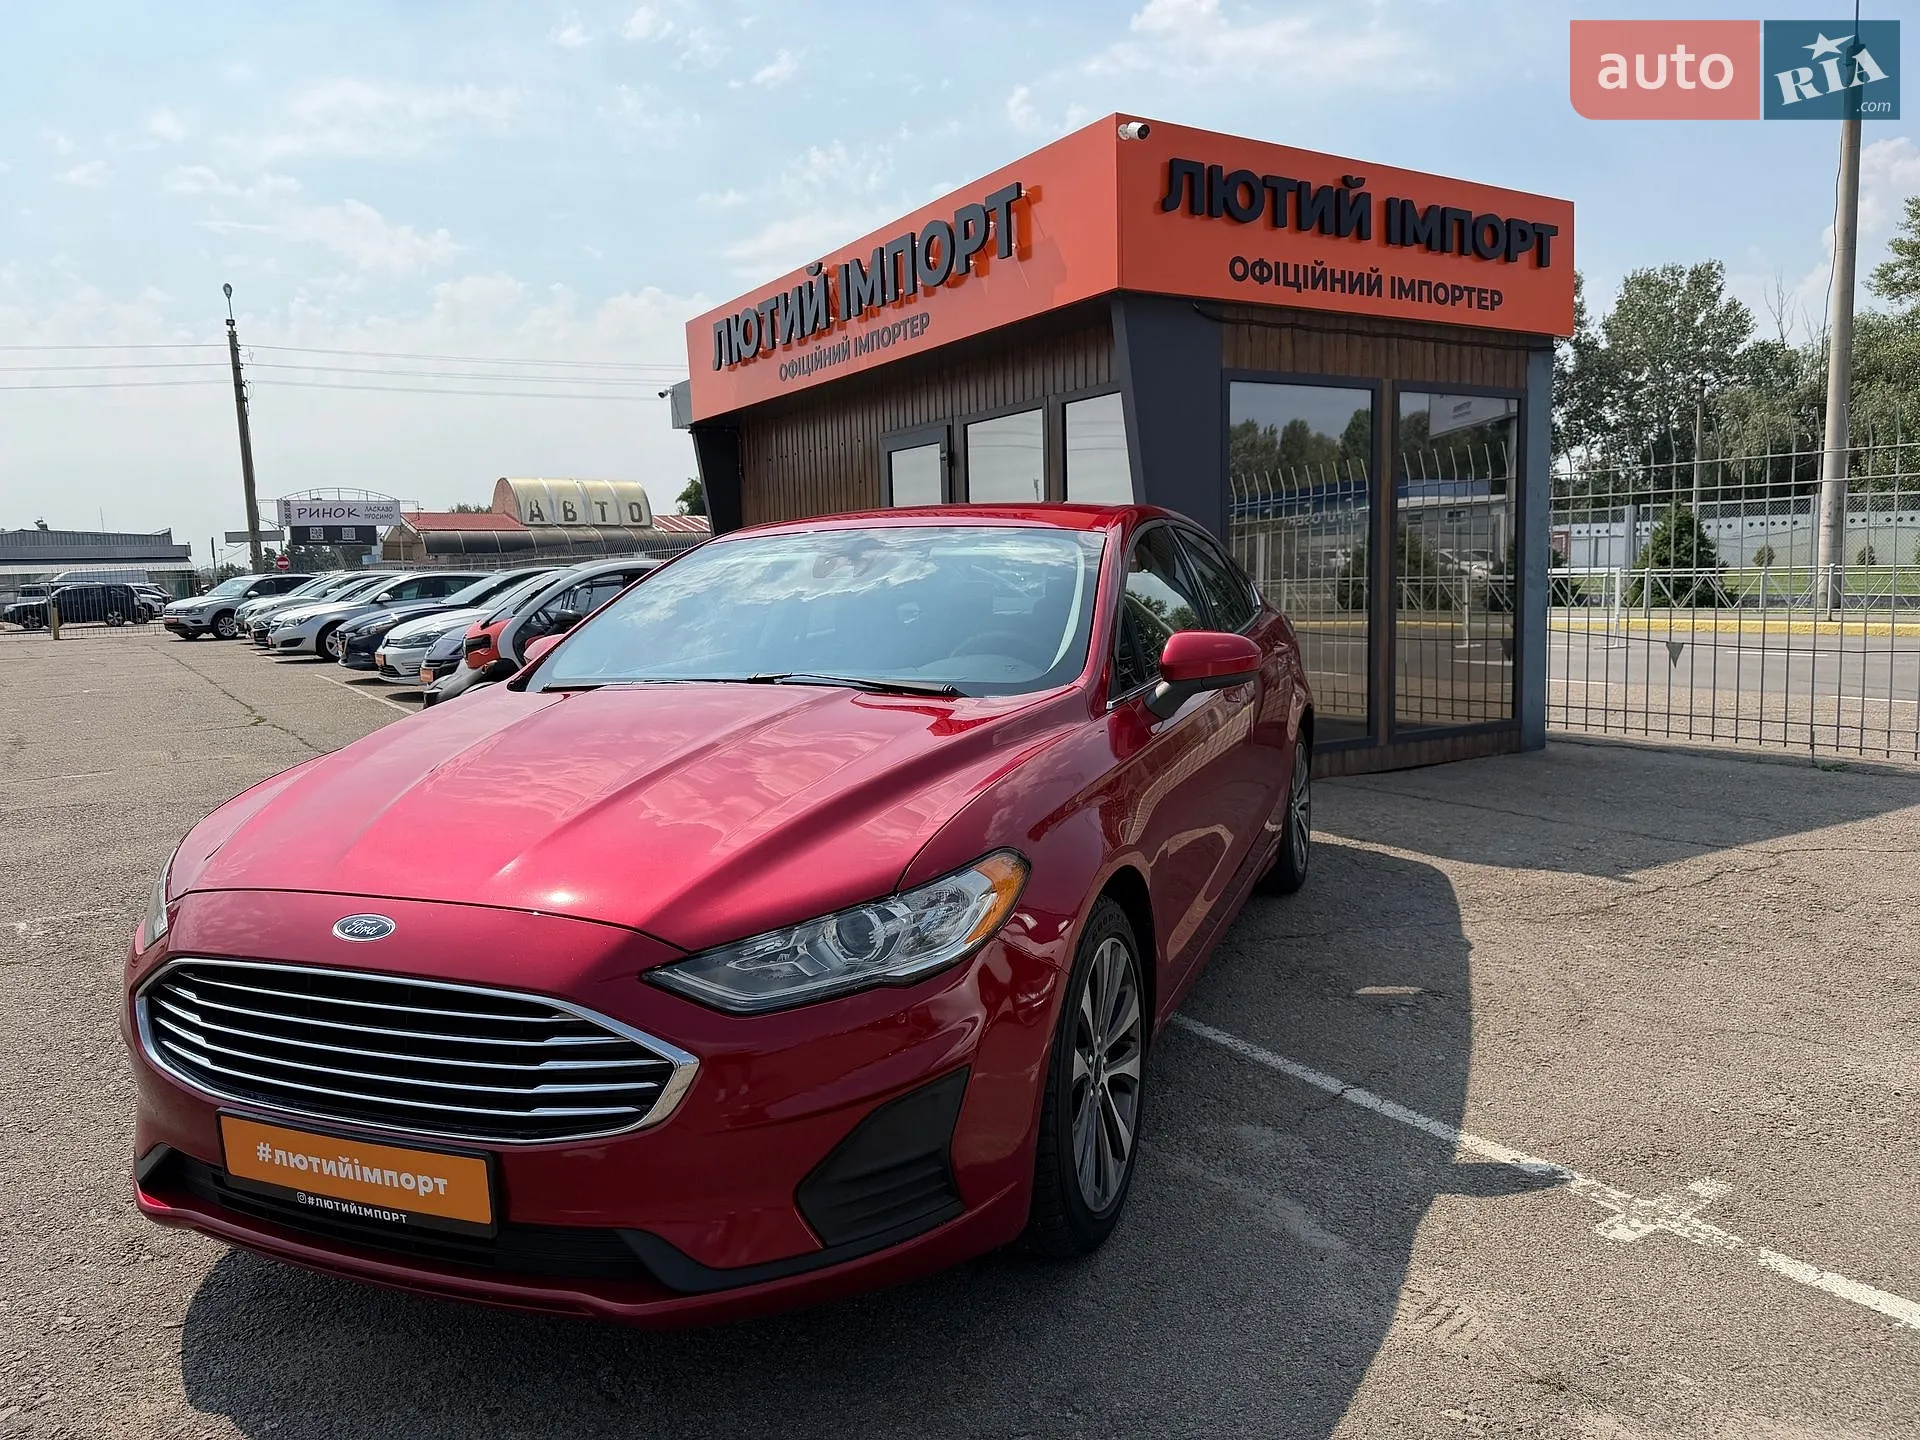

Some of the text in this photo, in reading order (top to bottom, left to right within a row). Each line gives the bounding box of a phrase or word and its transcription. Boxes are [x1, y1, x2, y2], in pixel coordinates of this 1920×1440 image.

[1161, 157, 1559, 269] ЛЮТИЙ ІМПОРТ
[712, 182, 1023, 371] ЛЮТИЙ ІМПОРТ
[1228, 255, 1504, 312] ОФІЦІЙНИЙ ІМПОРТЕР
[778, 312, 930, 383] ОФІЦІЙНИЙ ІМПОРТЕР
[296, 507, 360, 518] РИНОК
[529, 499, 644, 523] АВТО
[344, 919, 382, 935] Ford
[255, 1141, 448, 1197] #лютийімпорт
